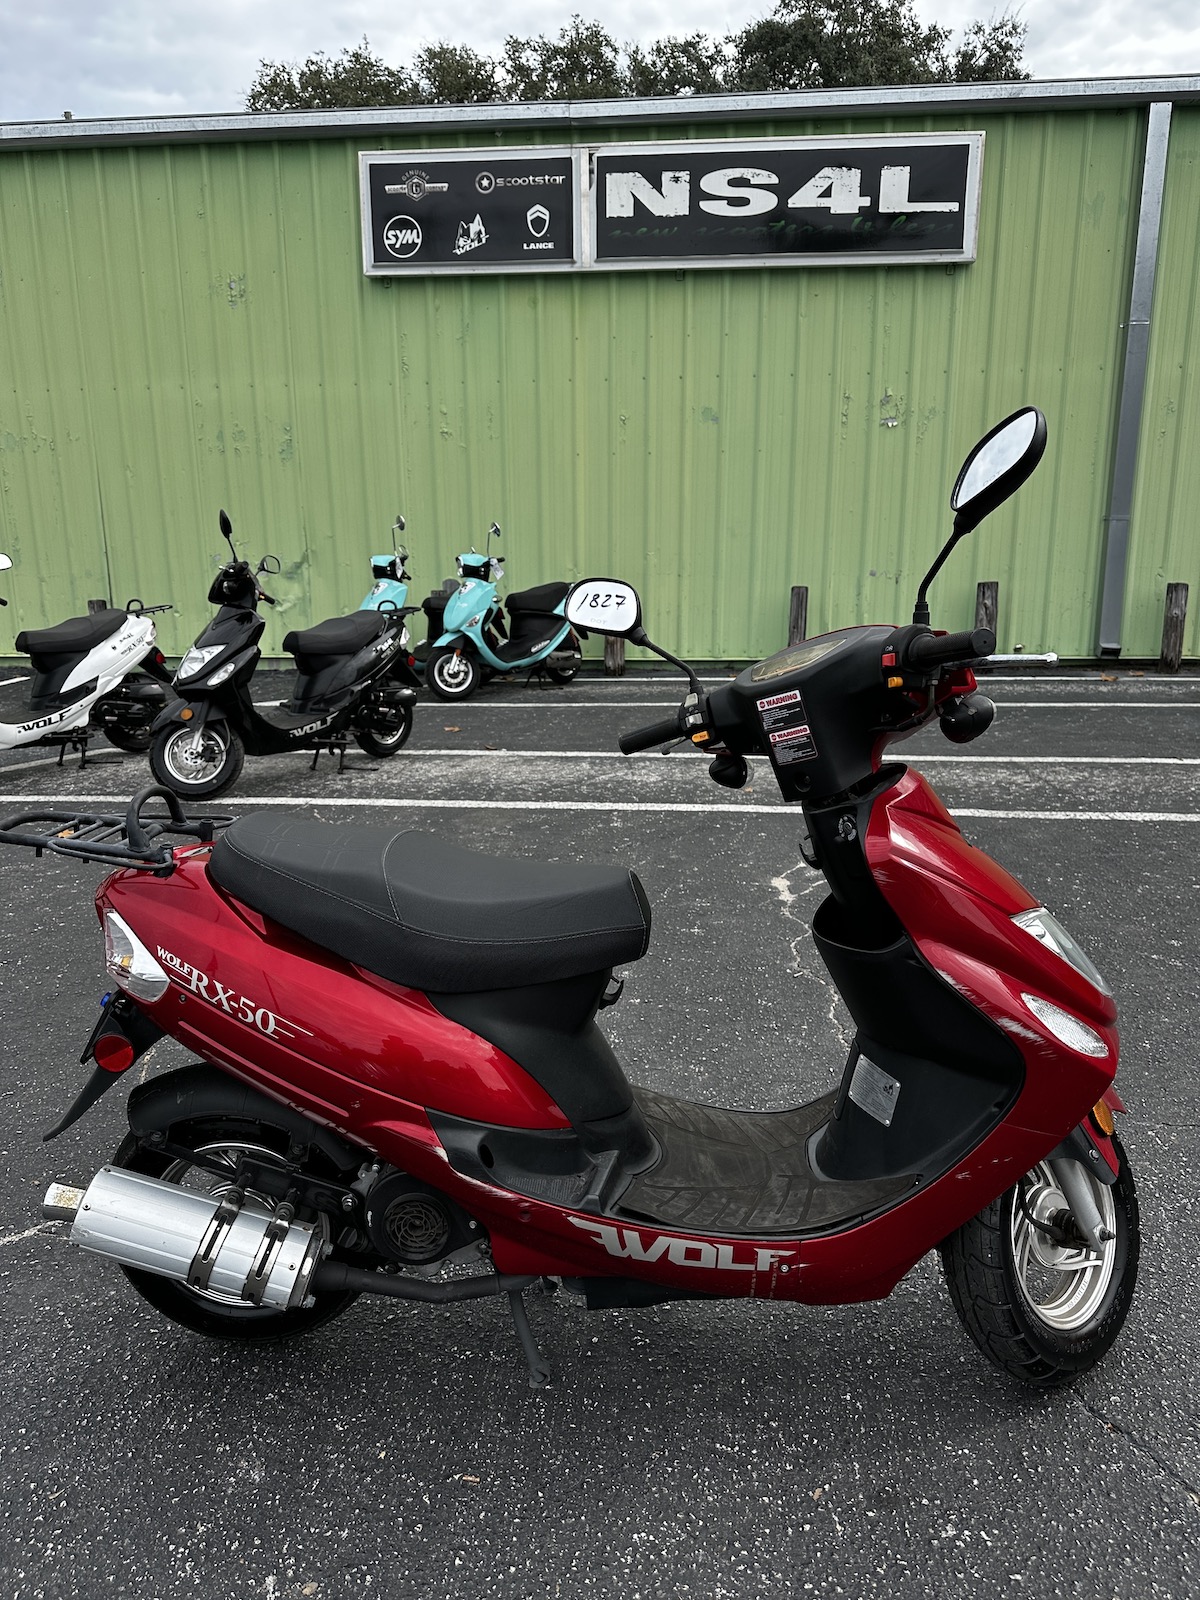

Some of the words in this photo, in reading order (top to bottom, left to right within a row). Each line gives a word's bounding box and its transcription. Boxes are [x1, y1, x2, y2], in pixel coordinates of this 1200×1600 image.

[401, 169, 430, 181] GENUINE
[496, 174, 566, 188] scootstar
[605, 165, 960, 218] NS4L
[386, 229, 420, 249] SYM
[607, 226, 679, 238] new
[452, 234, 490, 255] WOLF
[523, 241, 555, 250] LANCE
[575, 592, 627, 613] 1827
[765, 692, 799, 707] WARNING
[17, 707, 74, 732] WOLF
[289, 710, 340, 737] WOLF
[777, 726, 809, 740] WARNING
[156, 944, 194, 975] WOLF
[190, 967, 280, 1040] RX-50
[564, 1214, 797, 1272] WOLF
